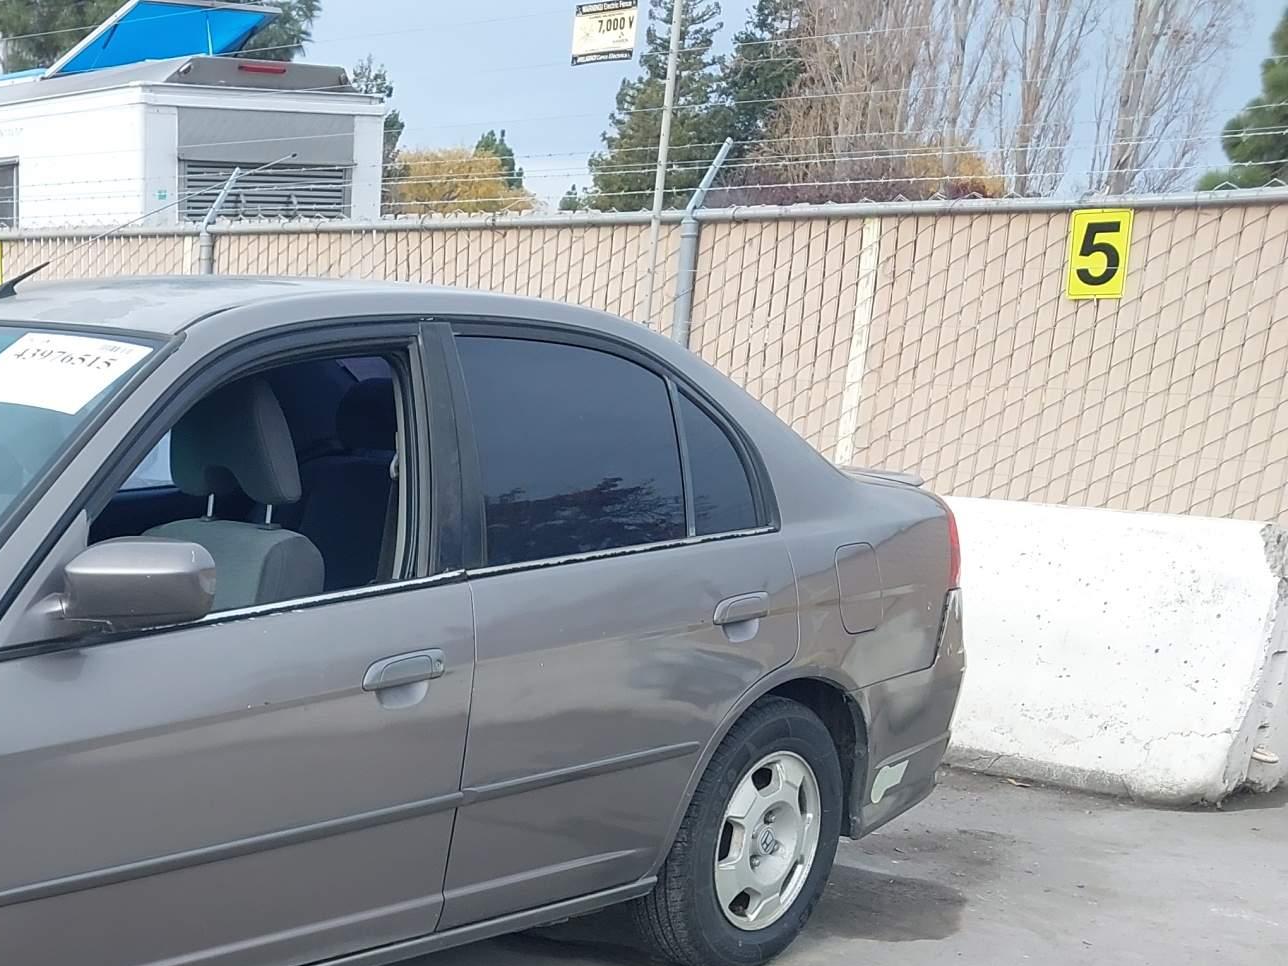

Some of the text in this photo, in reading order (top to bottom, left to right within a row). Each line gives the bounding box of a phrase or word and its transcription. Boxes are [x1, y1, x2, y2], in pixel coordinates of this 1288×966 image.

[598, 16, 635, 34] 7,000 V
[1076, 220, 1121, 286] 5
[14, 348, 117, 371] 43976515
